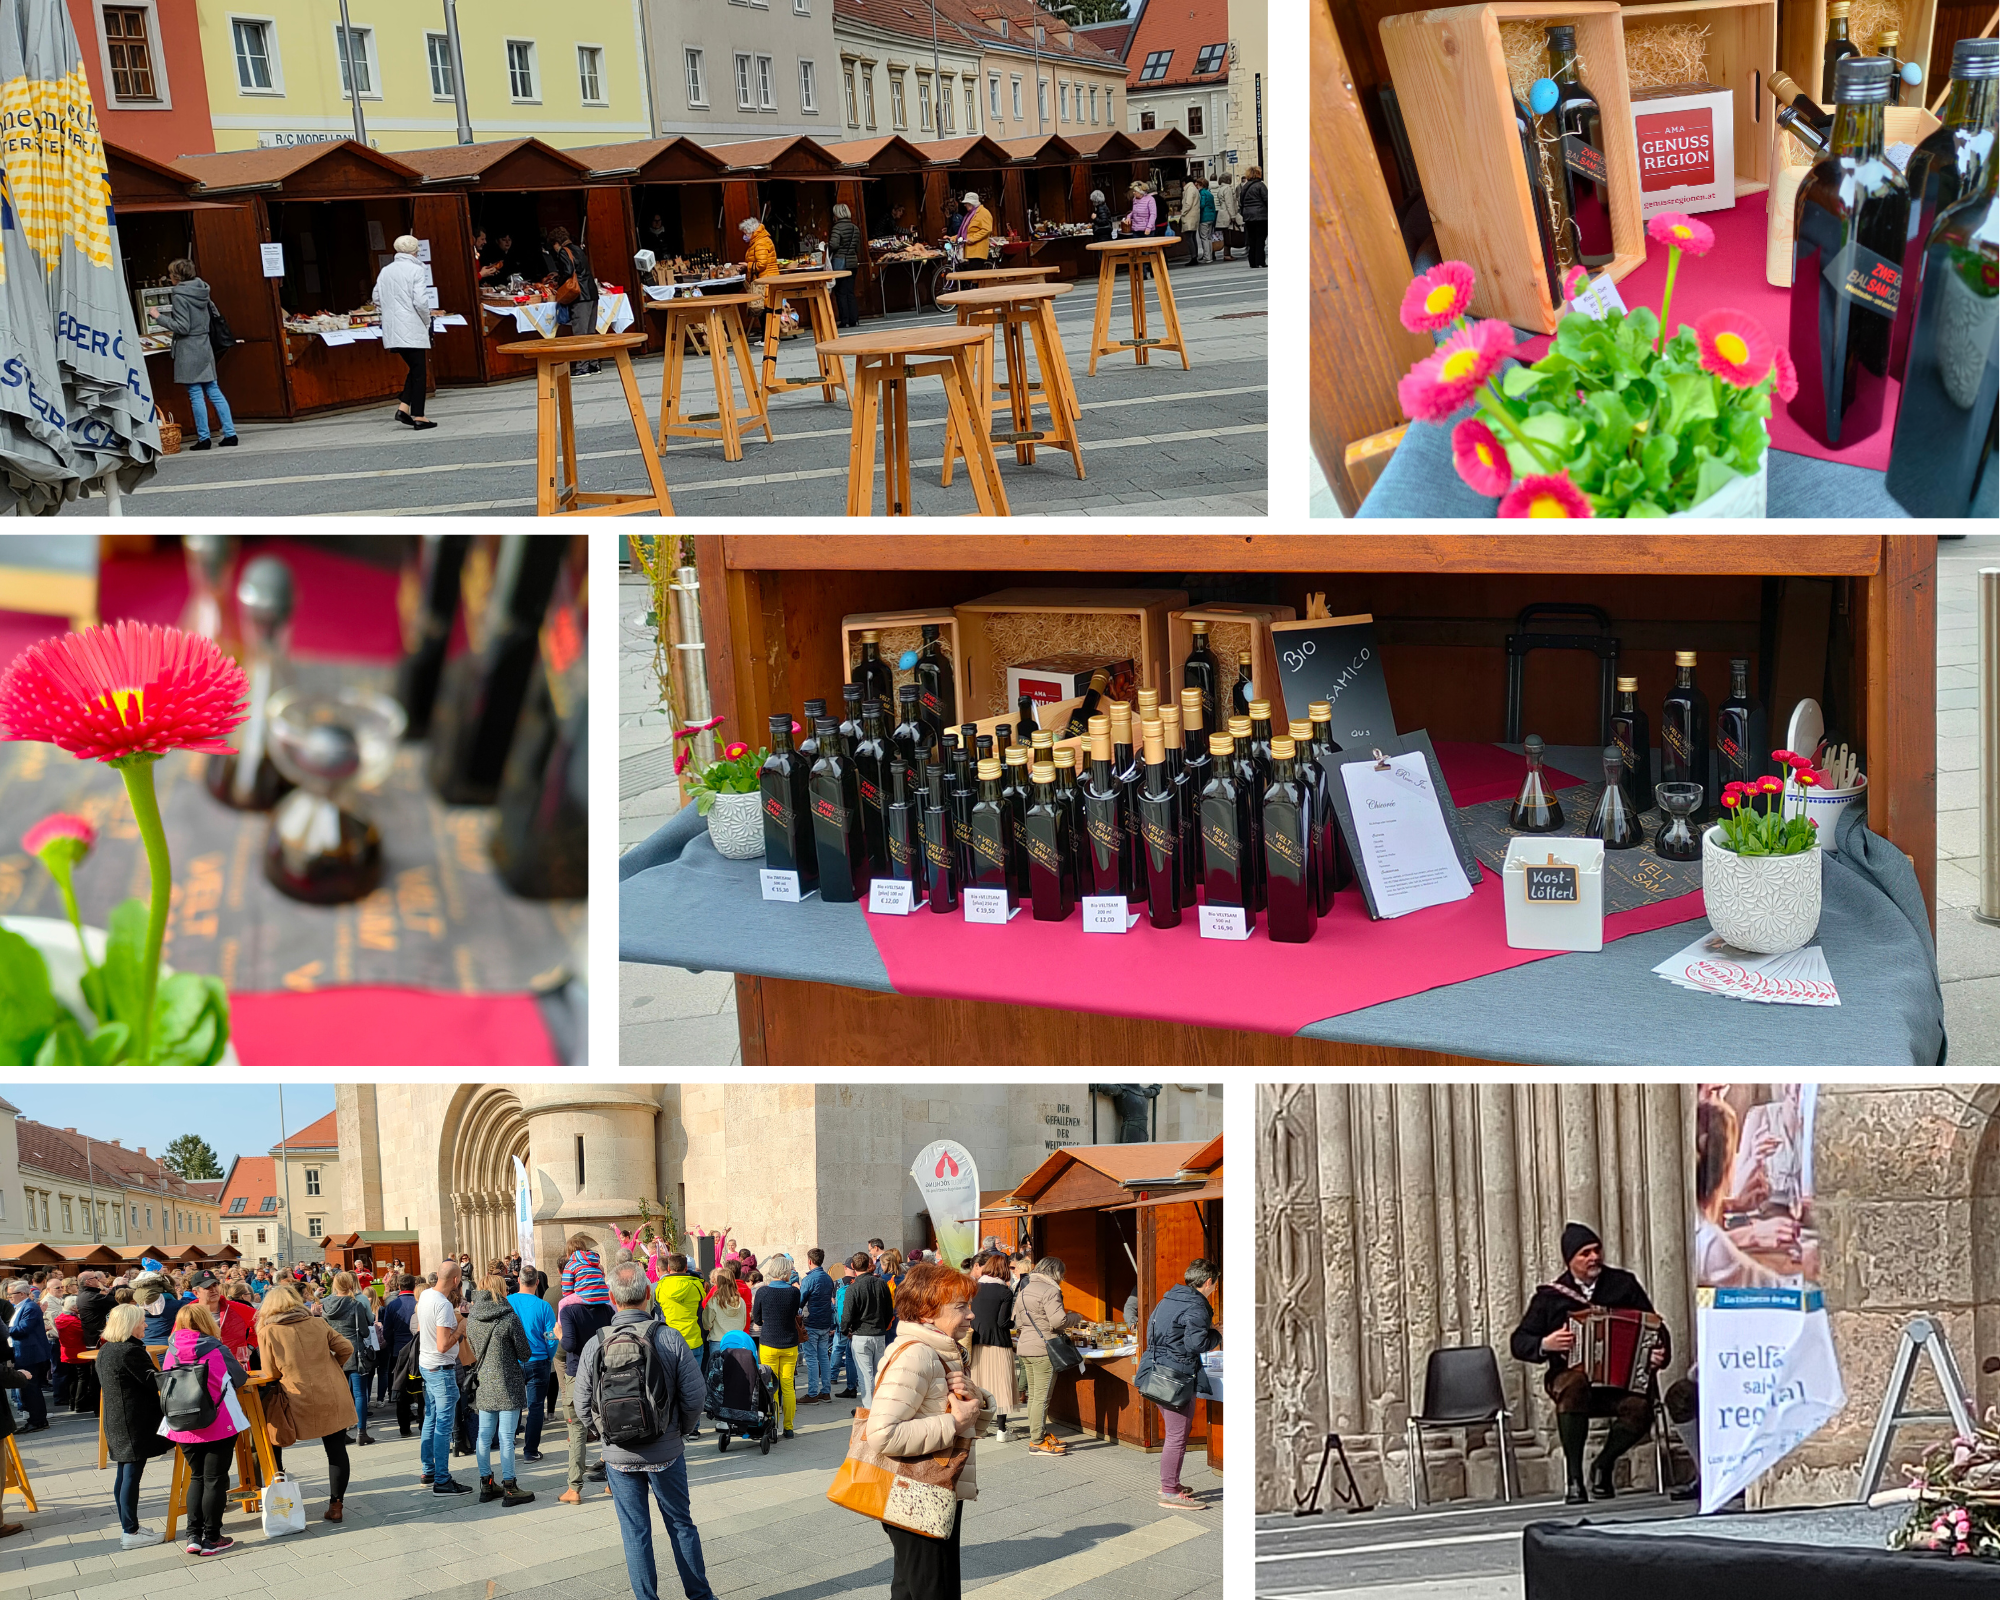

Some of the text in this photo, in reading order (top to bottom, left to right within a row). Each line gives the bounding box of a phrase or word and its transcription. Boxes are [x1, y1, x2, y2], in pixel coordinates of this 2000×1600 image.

[1664, 126, 1686, 134] AMA
[275, 134, 294, 145] R/C
[1642, 135, 1710, 154] GENUSS
[1644, 150, 1710, 170] REGION
[1644, 193, 1716, 210] genussregionen.at
[1284, 640, 1316, 672] BIO
[1326, 648, 1370, 704] SAMICO
[1350, 730, 1370, 738] aus
[1533, 870, 1571, 884] Kost-
[1638, 858, 1674, 883] VELT
[1058, 1104, 1070, 1114] DEN
[1046, 1114, 1080, 1126] GEFALLENEN
[1056, 1128, 1070, 1138] DER
